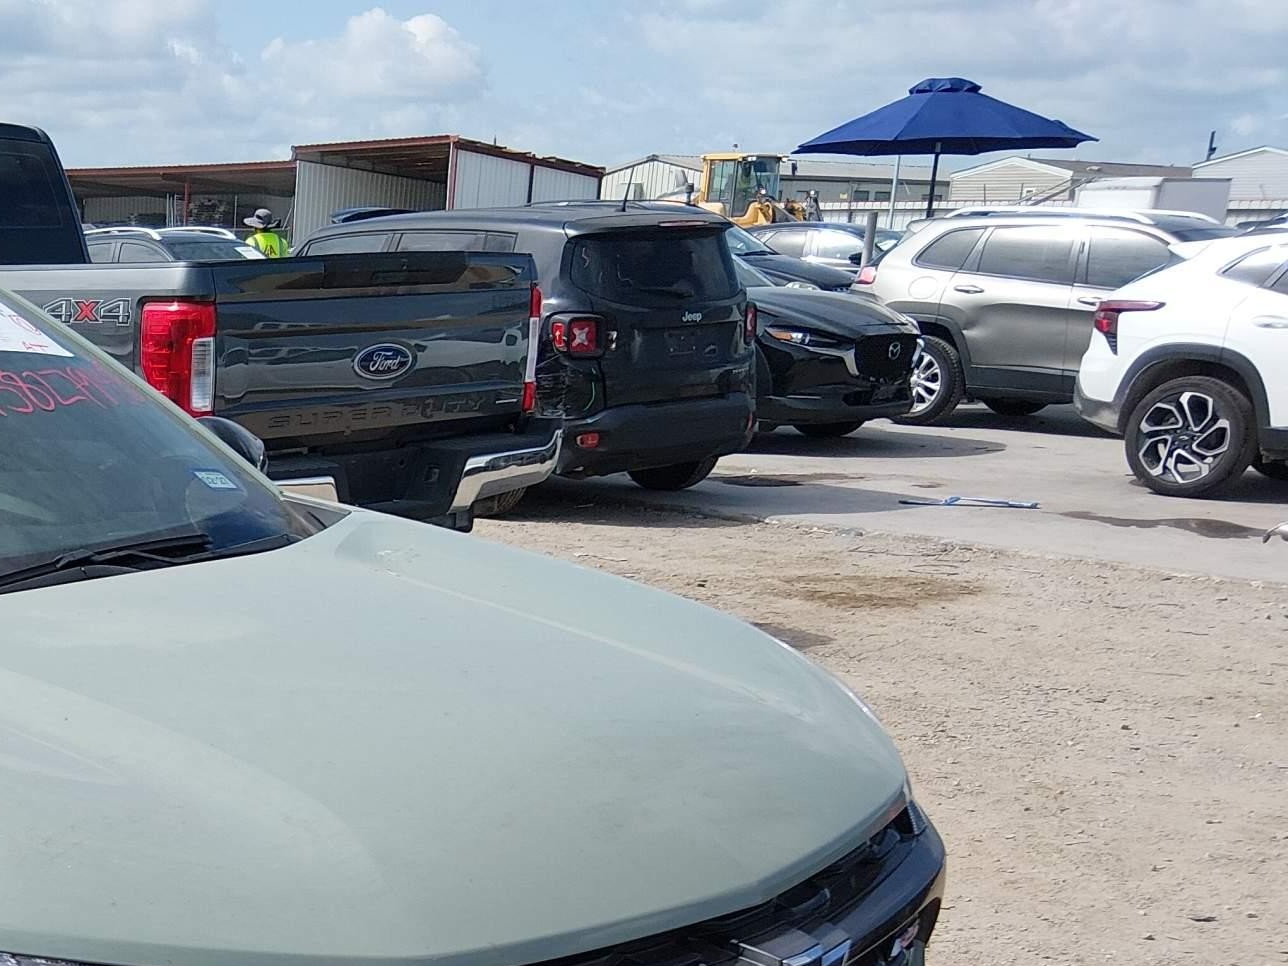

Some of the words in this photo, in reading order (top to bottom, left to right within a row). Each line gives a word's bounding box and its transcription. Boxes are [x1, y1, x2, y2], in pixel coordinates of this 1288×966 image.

[681, 311, 702, 323] Jeep
[368, 350, 402, 372] Ford
[267, 402, 394, 430] SUPER
